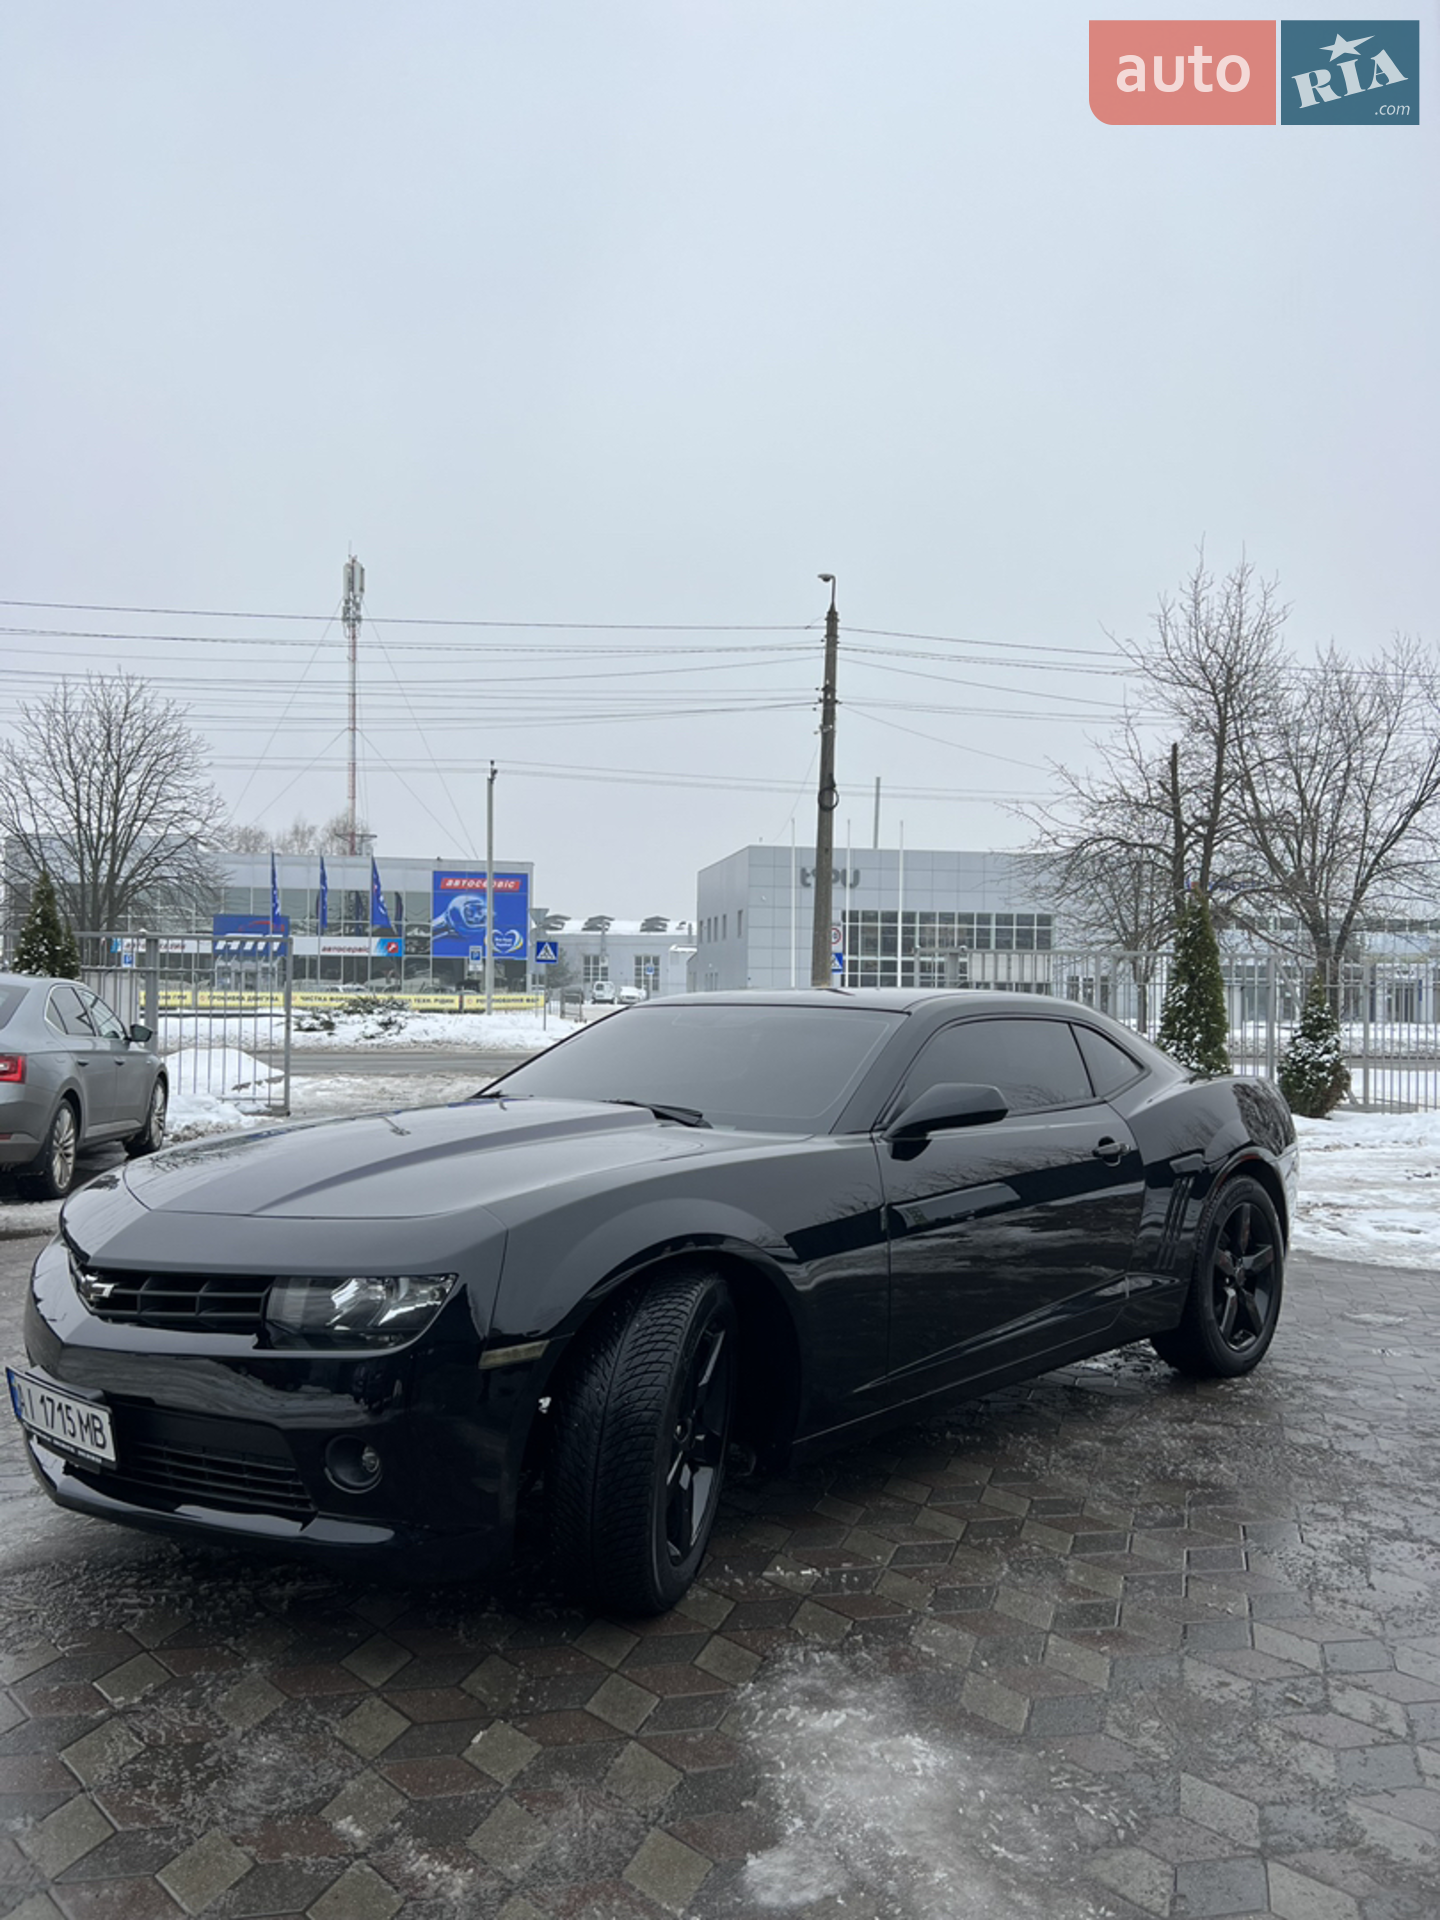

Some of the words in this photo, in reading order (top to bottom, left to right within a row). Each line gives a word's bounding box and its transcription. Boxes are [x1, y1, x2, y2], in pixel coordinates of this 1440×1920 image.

[321, 944, 371, 954] автосервіс
[39, 1394, 77, 1438] 1715
[77, 1409, 107, 1449] MB
